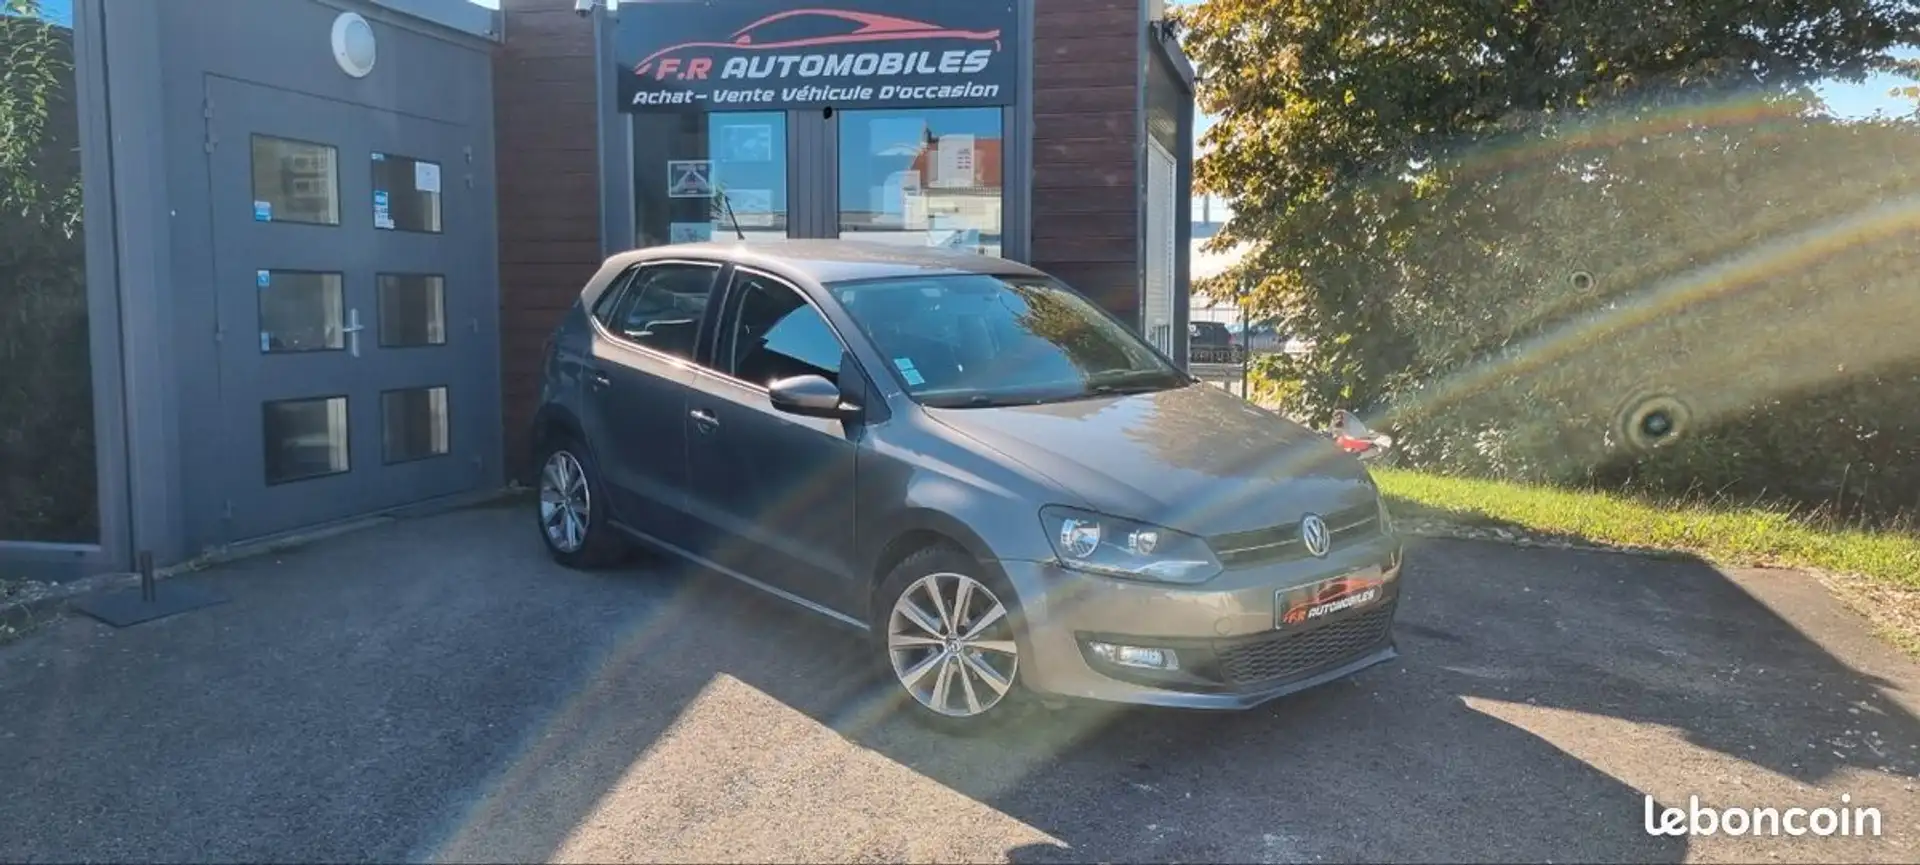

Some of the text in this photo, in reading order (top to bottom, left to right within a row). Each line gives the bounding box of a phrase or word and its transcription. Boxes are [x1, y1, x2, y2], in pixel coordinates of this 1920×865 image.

[655, 50, 992, 81] F.R AUTOMOBILES
[713, 88, 775, 103] Vente
[780, 84, 873, 101] Véhicule
[879, 81, 999, 99] D'occasion
[1307, 588, 1375, 618] AUTOMOBILES
